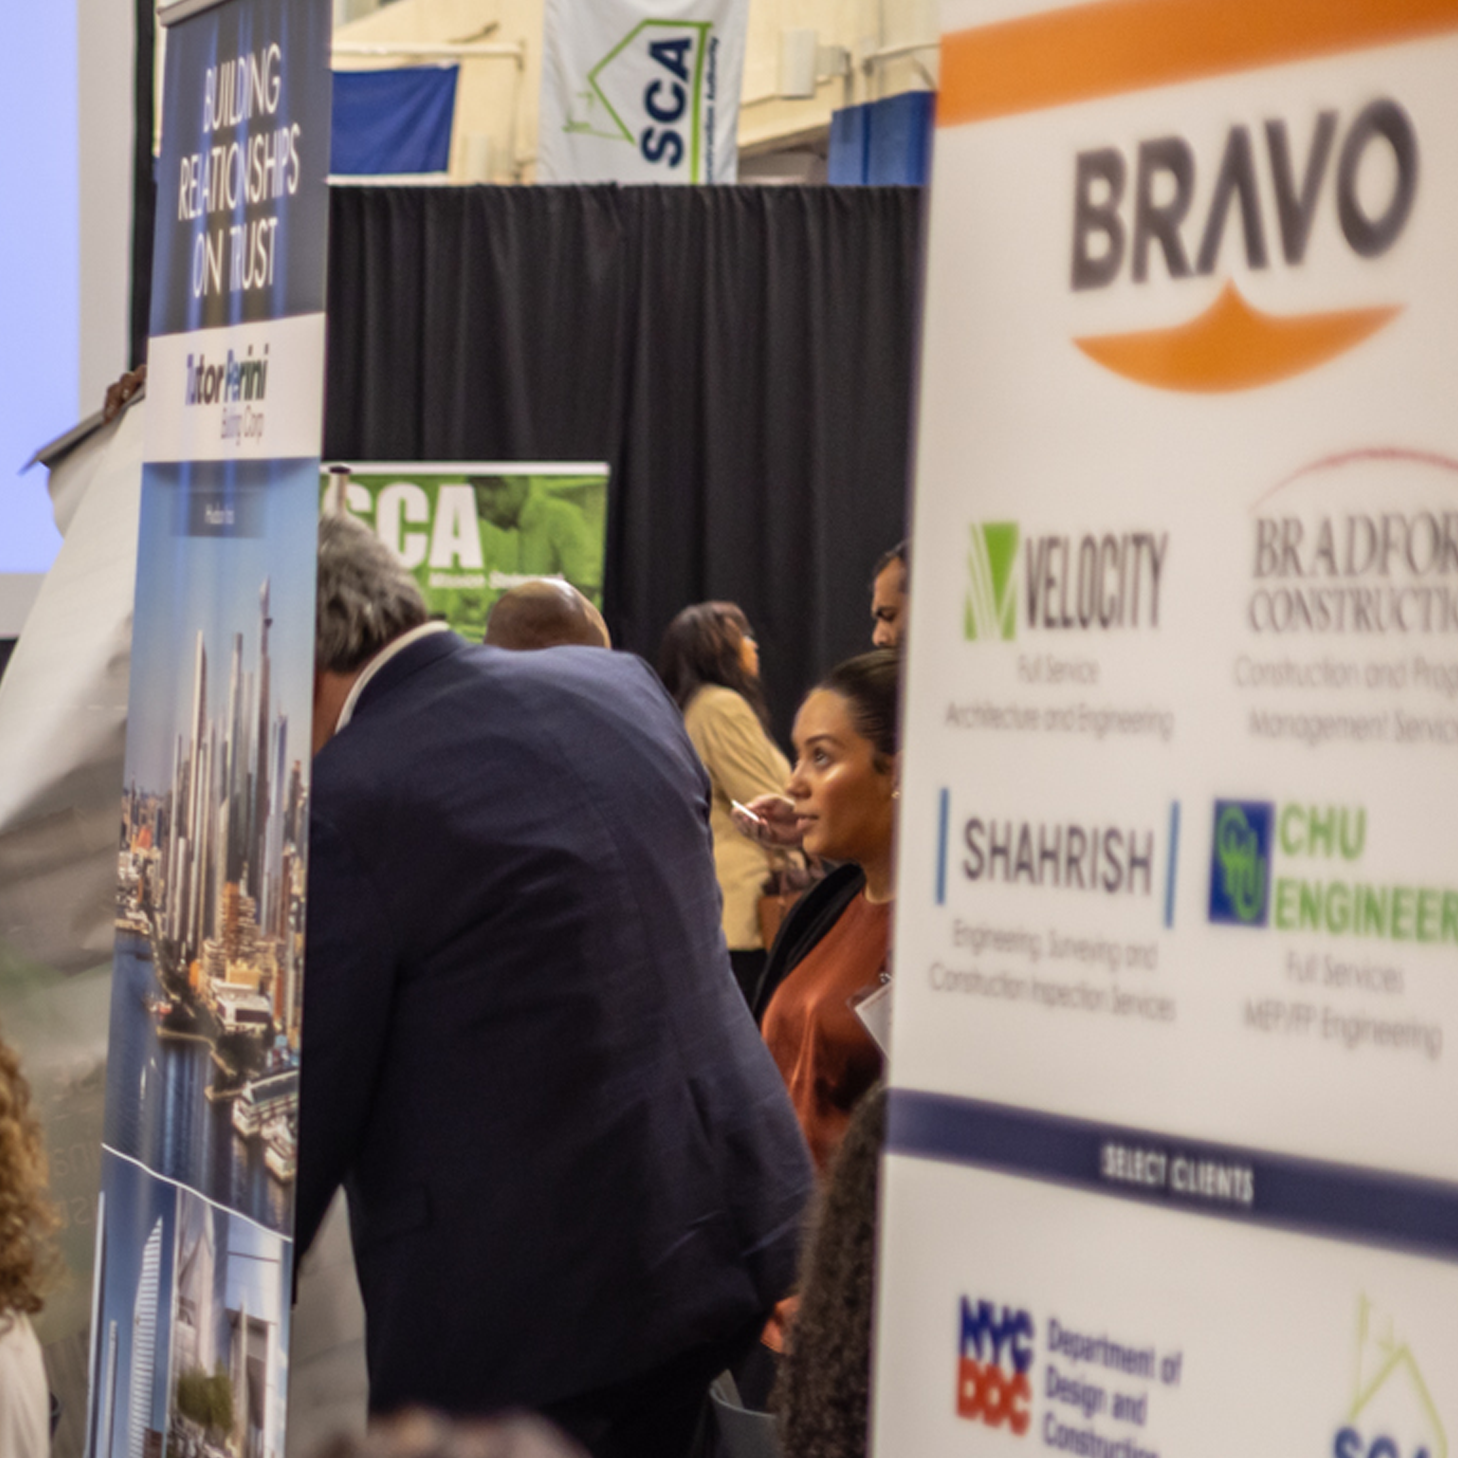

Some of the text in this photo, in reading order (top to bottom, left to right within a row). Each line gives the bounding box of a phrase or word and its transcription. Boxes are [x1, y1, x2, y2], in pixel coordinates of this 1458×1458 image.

[203, 43, 281, 133] BUILDING
[640, 37, 692, 168] SCA
[178, 123, 301, 221] RELATIONSHIPS
[1071, 96, 1420, 291] BRAVO
[193, 217, 278, 298] ON TRUST
[1025, 532, 1169, 629] VELOCITY
[1235, 655, 1358, 688] Construction
[1365, 657, 1407, 689] and
[945, 701, 1040, 730] Architecture
[1078, 703, 1174, 742] Engineering
[1248, 708, 1386, 747] Management
[962, 816, 1155, 896] SHAHRISH
[1280, 803, 1367, 862] CHU
[929, 962, 1029, 1000] Construction
[1321, 1005, 1443, 1061] Engineering
[1103, 1143, 1254, 1203] SELECT CLIENTS
[958, 1294, 1035, 1374] NYC
[1047, 1315, 1183, 1387] Department of
[955, 1355, 1032, 1438] DDC
[1045, 1364, 1148, 1428] Design and
